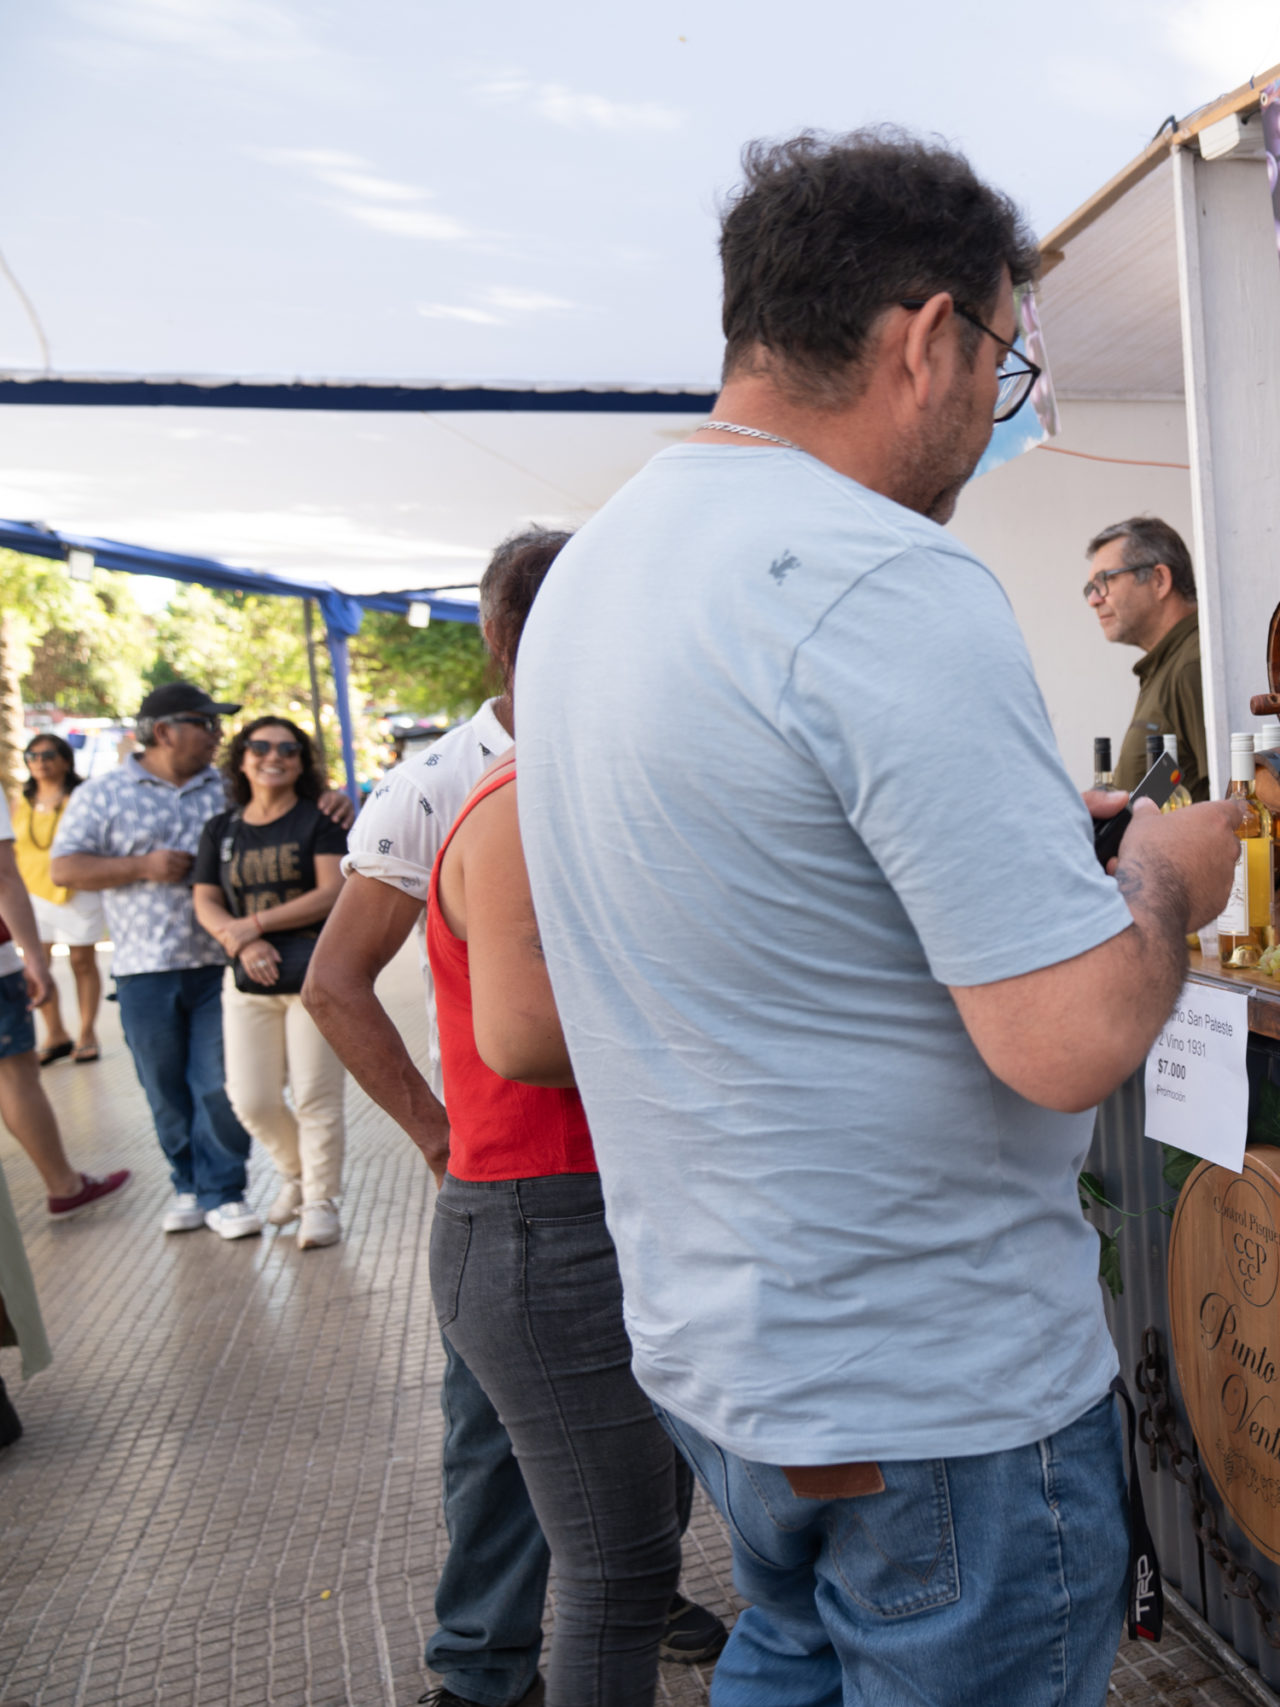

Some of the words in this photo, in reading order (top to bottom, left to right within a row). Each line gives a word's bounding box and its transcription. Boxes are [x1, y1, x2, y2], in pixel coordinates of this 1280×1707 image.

[1187, 1009, 1203, 1028] San
[1205, 1014, 1233, 1037] Pateste
[1165, 1032, 1185, 1052] Vino
[1187, 1038, 1206, 1057] 1931
[1157, 1058, 1186, 1080] $7.000
[1213, 1196, 1248, 1228] Control
[1200, 1292, 1277, 1384] Punto
[1136, 1554, 1154, 1623] TRD
